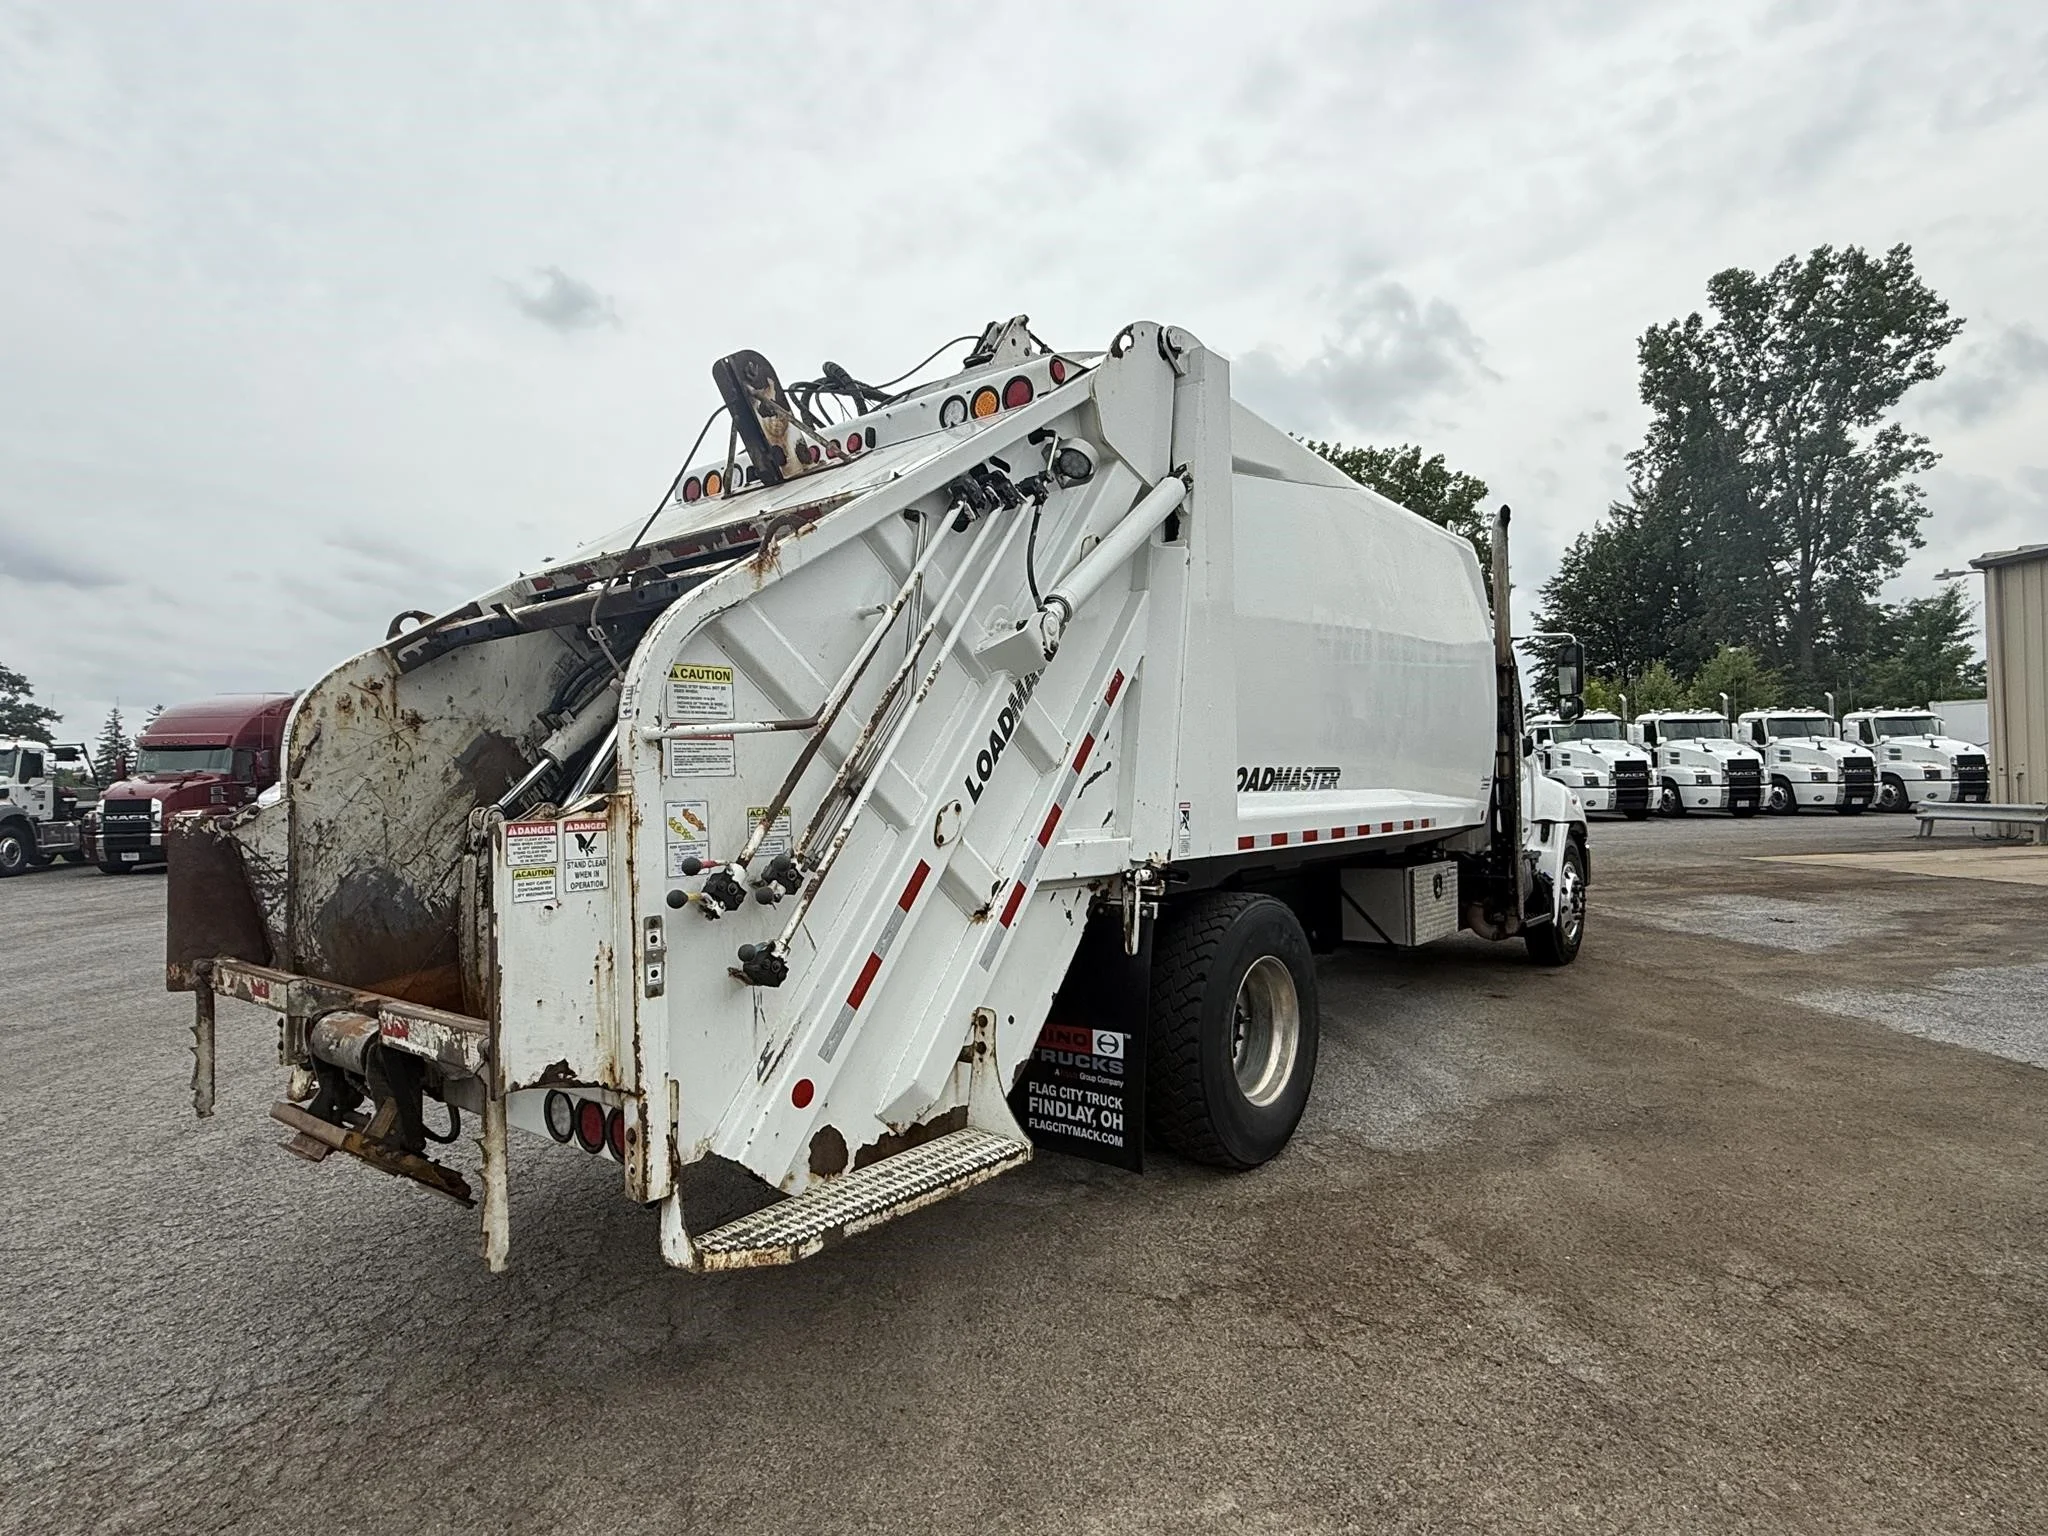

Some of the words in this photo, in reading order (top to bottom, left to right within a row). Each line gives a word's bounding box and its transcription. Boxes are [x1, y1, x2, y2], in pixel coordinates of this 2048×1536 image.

[680, 668, 731, 681] CAUTION
[517, 825, 556, 835] DANGER
[573, 822, 607, 831] DANGER
[567, 861, 586, 869] STAND
[588, 860, 606, 868] CLEAR
[521, 869, 554, 878] CAUTION
[575, 871, 592, 879] WHEN
[570, 880, 604, 890] OPERATION
[1080, 1072, 1097, 1083] Group
[1098, 1076, 1124, 1089] Company
[1029, 1081, 1057, 1097] FLAG
[1060, 1087, 1084, 1102] CITY
[1085, 1091, 1123, 1110] TRUCK
[1029, 1096, 1097, 1128] FINDLAY,
[1100, 1110, 1124, 1132] OH
[1029, 1118, 1124, 1148] FLAGCITYMACK.COM
